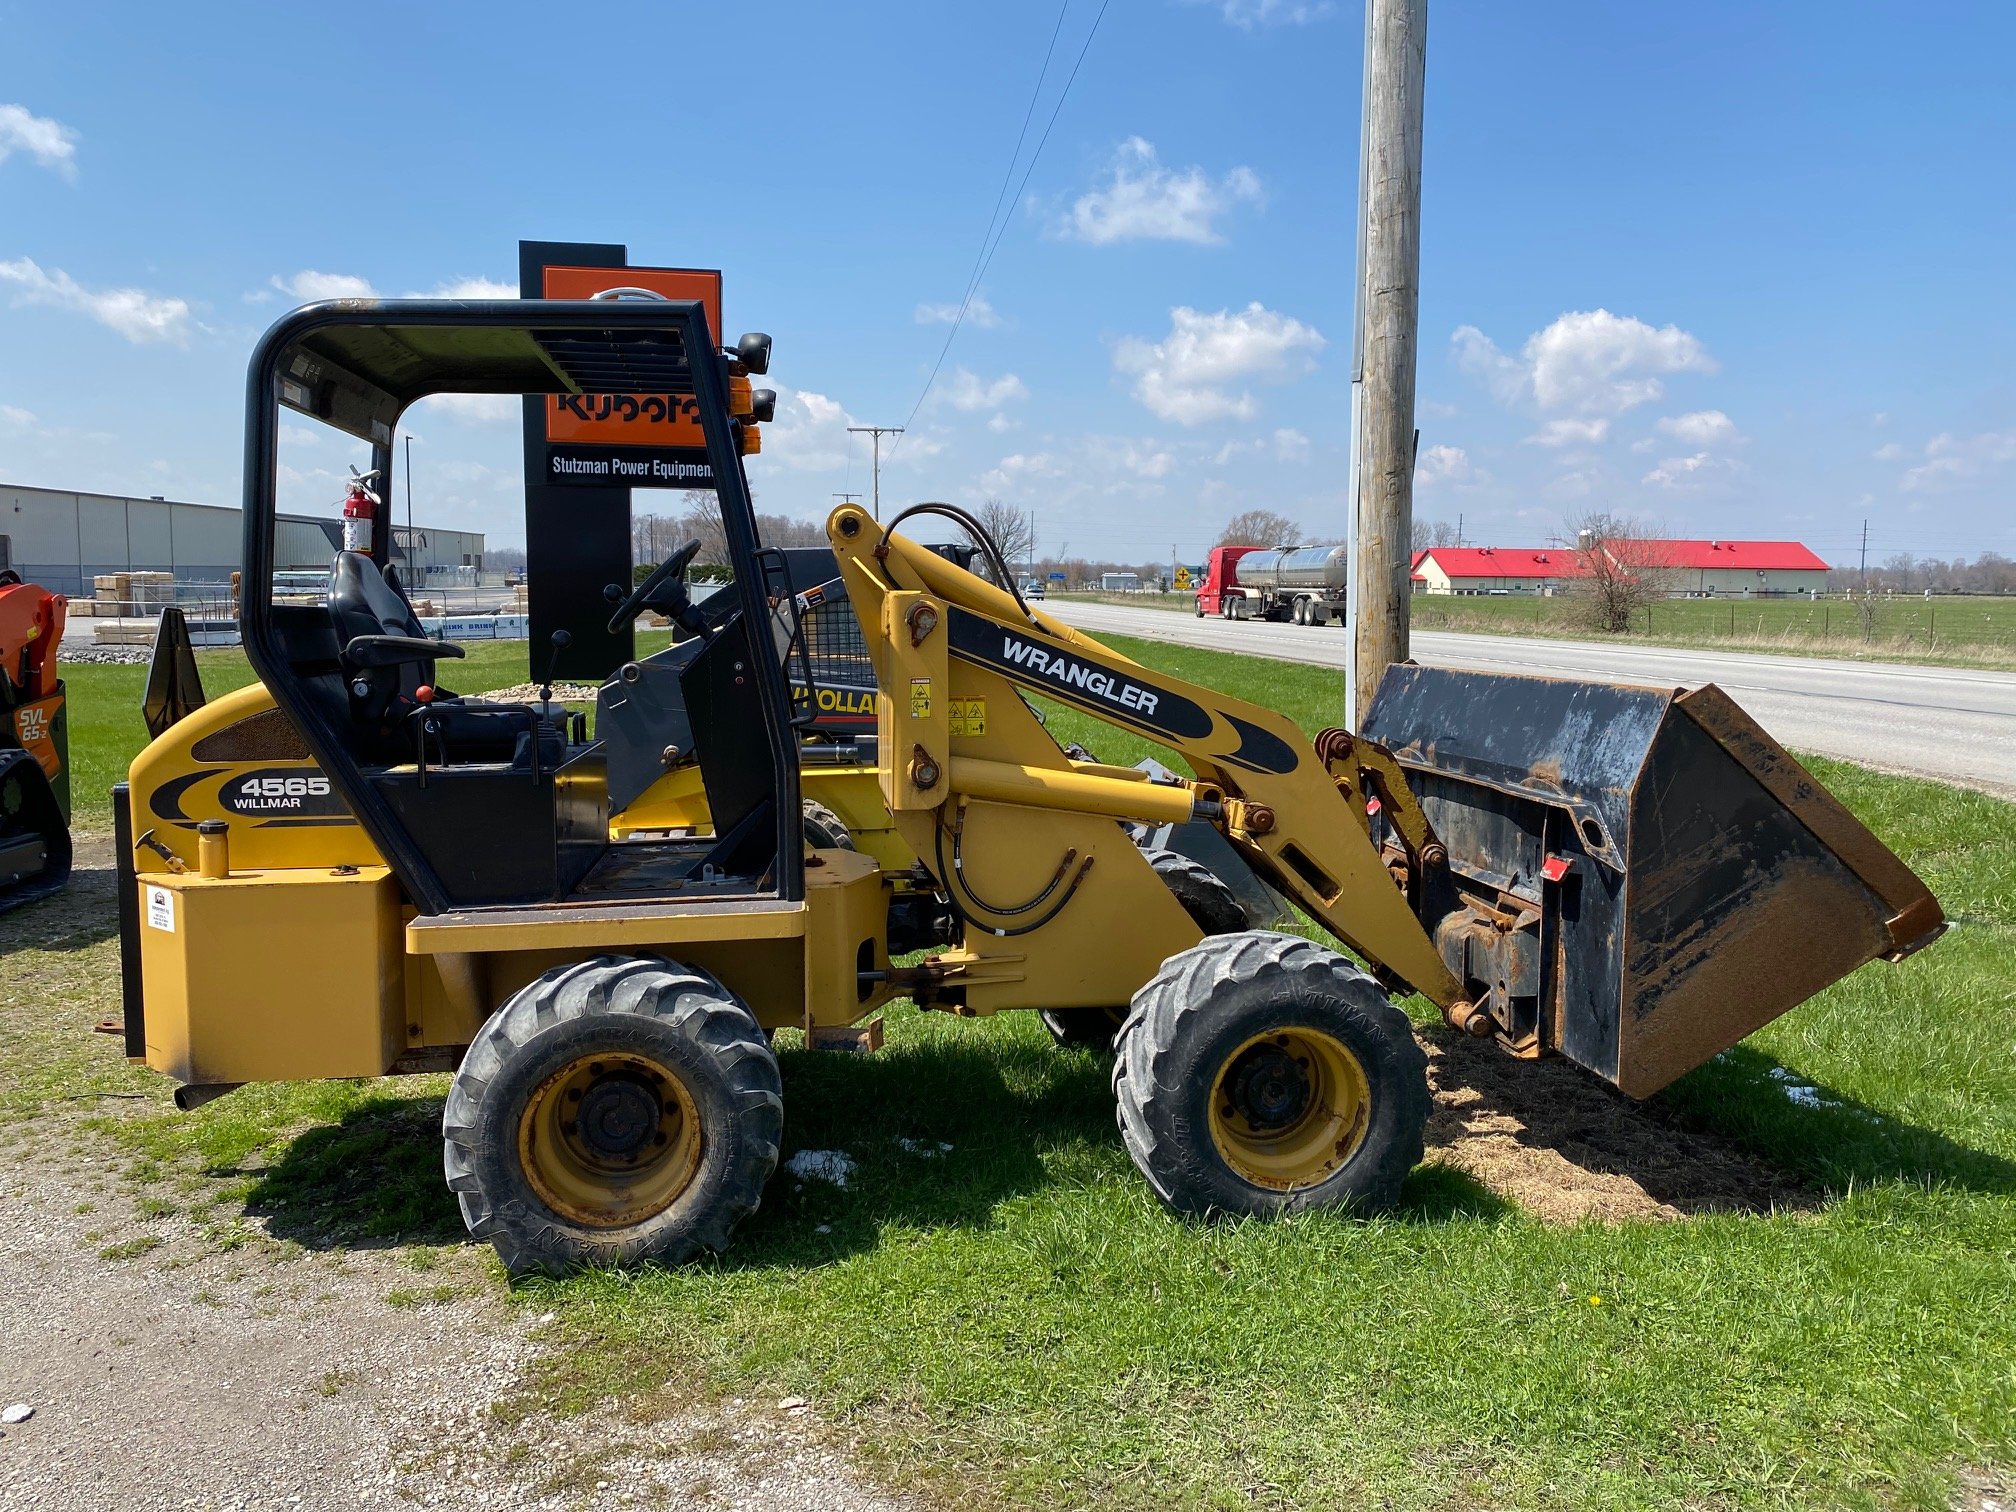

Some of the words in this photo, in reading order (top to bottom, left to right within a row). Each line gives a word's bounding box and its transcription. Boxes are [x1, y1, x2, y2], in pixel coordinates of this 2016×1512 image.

[553, 456, 608, 475] Stutzman
[612, 458, 650, 476] Power
[653, 459, 713, 480] Equipmen
[1003, 636, 1159, 715] WRANGLER
[18, 708, 48, 727] SVL
[241, 777, 331, 797] 4565
[233, 797, 301, 809] WILLMAR
